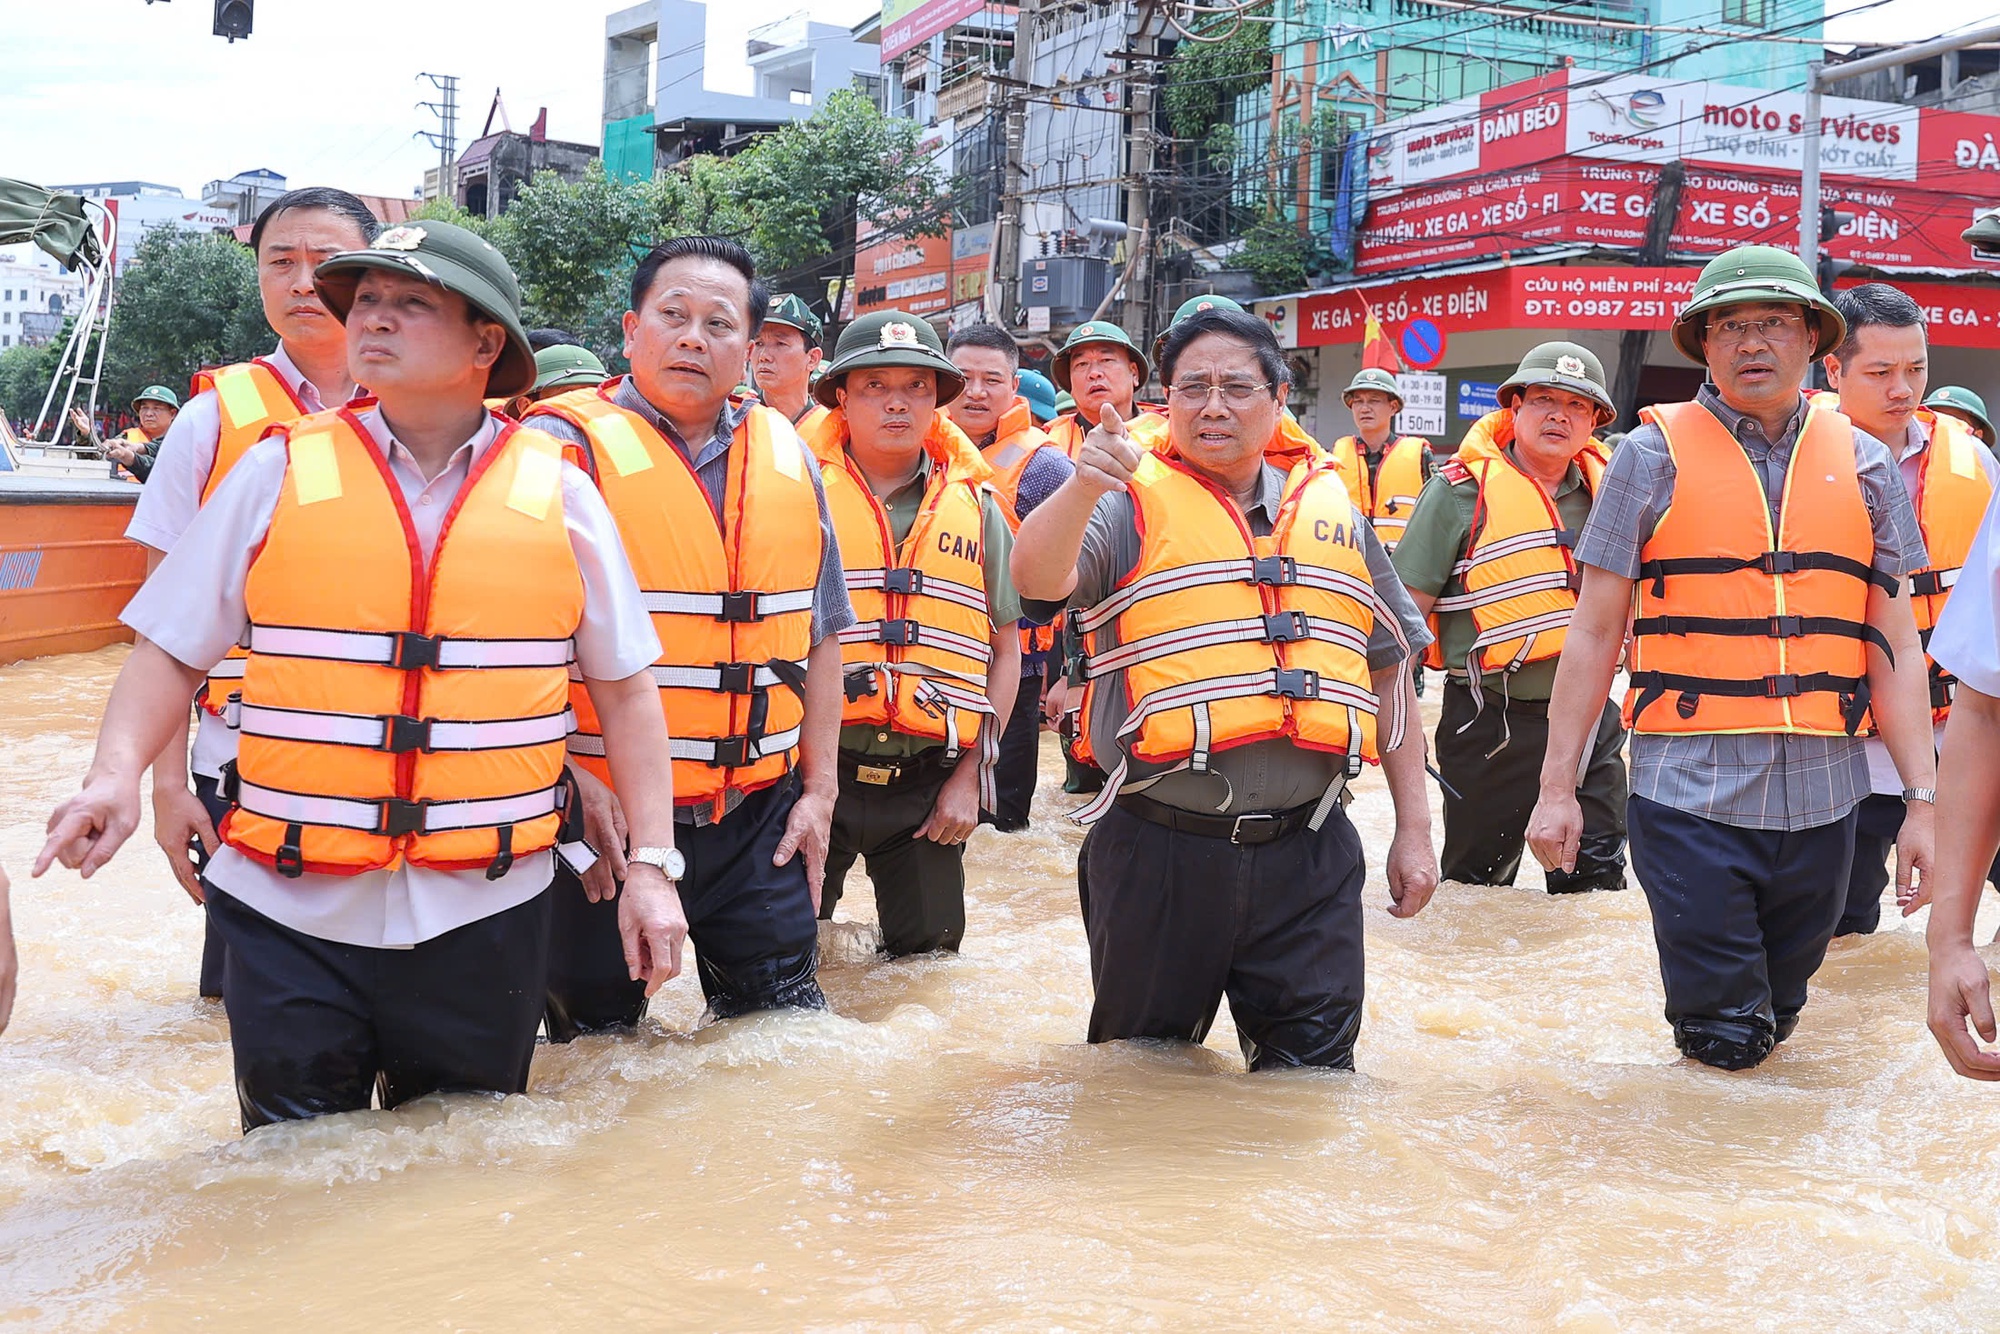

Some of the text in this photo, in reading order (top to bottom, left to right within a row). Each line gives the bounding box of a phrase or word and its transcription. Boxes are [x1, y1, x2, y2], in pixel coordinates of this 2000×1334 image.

[1704, 104, 1900, 145] moto srvices
[1588, 131, 1664, 149] TotalEnergies
[1581, 165, 1633, 182] TRUNG
[1424, 216, 1444, 238] XE
[1446, 211, 1469, 233] GA
[1481, 204, 1502, 227] XE
[1542, 192, 1559, 216] FI
[1580, 190, 1618, 215] XE
[1690, 200, 1727, 225] XE
[1732, 196, 1771, 229] SỐ
[1524, 276, 1557, 292] CỨU
[1562, 279, 1585, 296] HỘ
[1590, 276, 1626, 293] MIỄN
[1633, 277, 1659, 293] PHÍ
[1312, 310, 1329, 330] XE
[1331, 308, 1352, 328] GA
[1386, 291, 1408, 322] SỐ
[1422, 295, 1443, 316] XE
[1447, 285, 1488, 319] ĐIỆN
[1524, 299, 1561, 316] ĐT:
[1568, 300, 1624, 316] 0987
[1630, 301, 1664, 316] 251
[1949, 308, 1979, 326] GA
[1408, 415, 1435, 431] 50m
